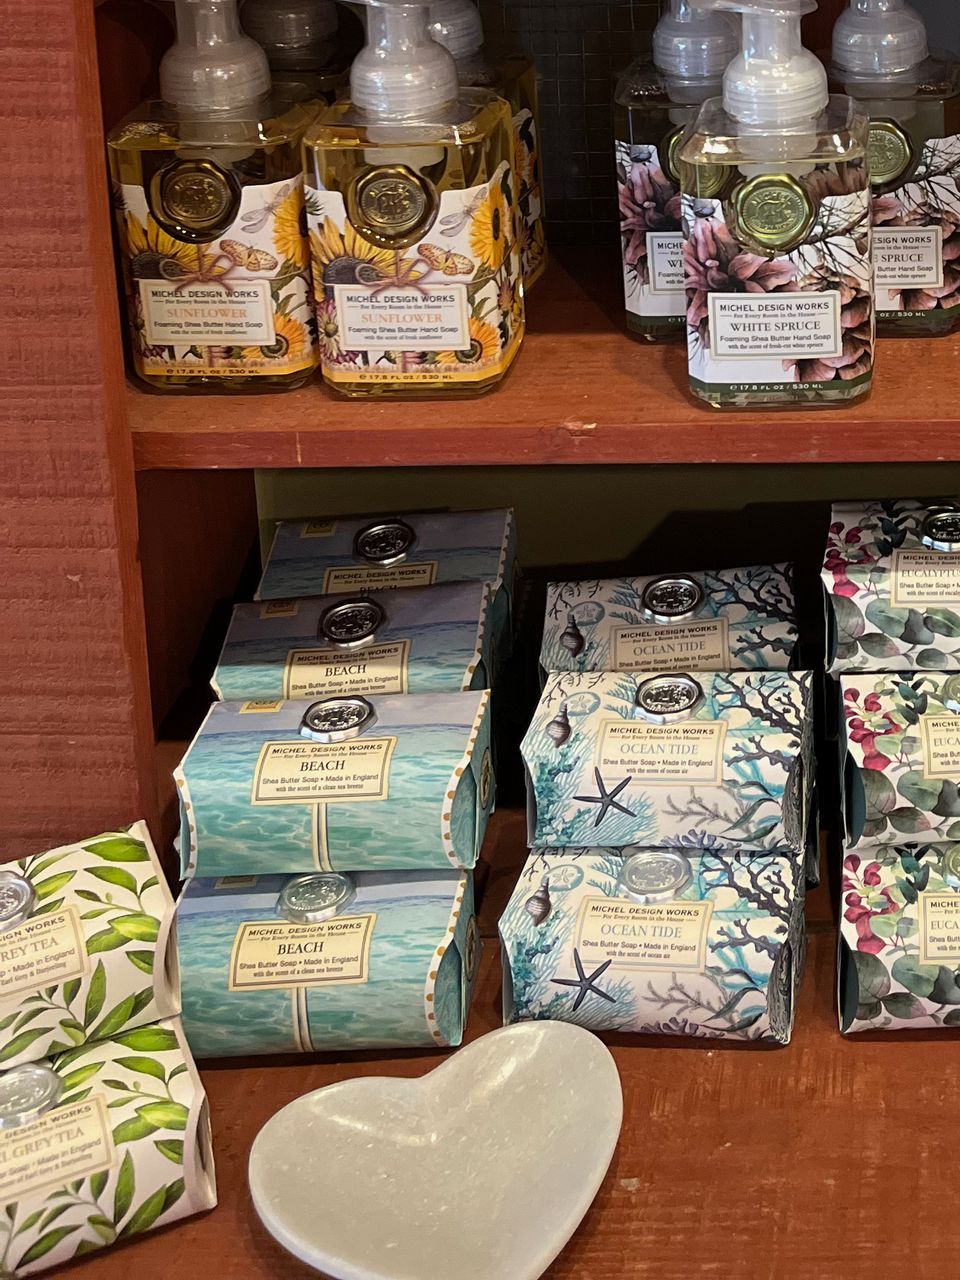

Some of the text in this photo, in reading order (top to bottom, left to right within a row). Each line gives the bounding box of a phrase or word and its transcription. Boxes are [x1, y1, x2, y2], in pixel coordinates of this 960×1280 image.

[795, 302, 829, 310] WORKS
[167, 308, 247, 318] SUNFLOWER
[362, 314, 442, 323] SUNFLOWER
[730, 321, 821, 331] WHITE SPRUCE
[620, 744, 699, 754] OCEAN TIDE
[300, 760, 345, 772] BEACH
[25, 915, 65, 933] WORKS
[601, 923, 682, 939] OCEAN TIDE
[30, 937, 59, 952] TEA
[277, 941, 324, 955] BEACH
[621, 941, 637, 949] Soap
[12, 962, 34, 972] Made
[45, 948, 75, 963] England
